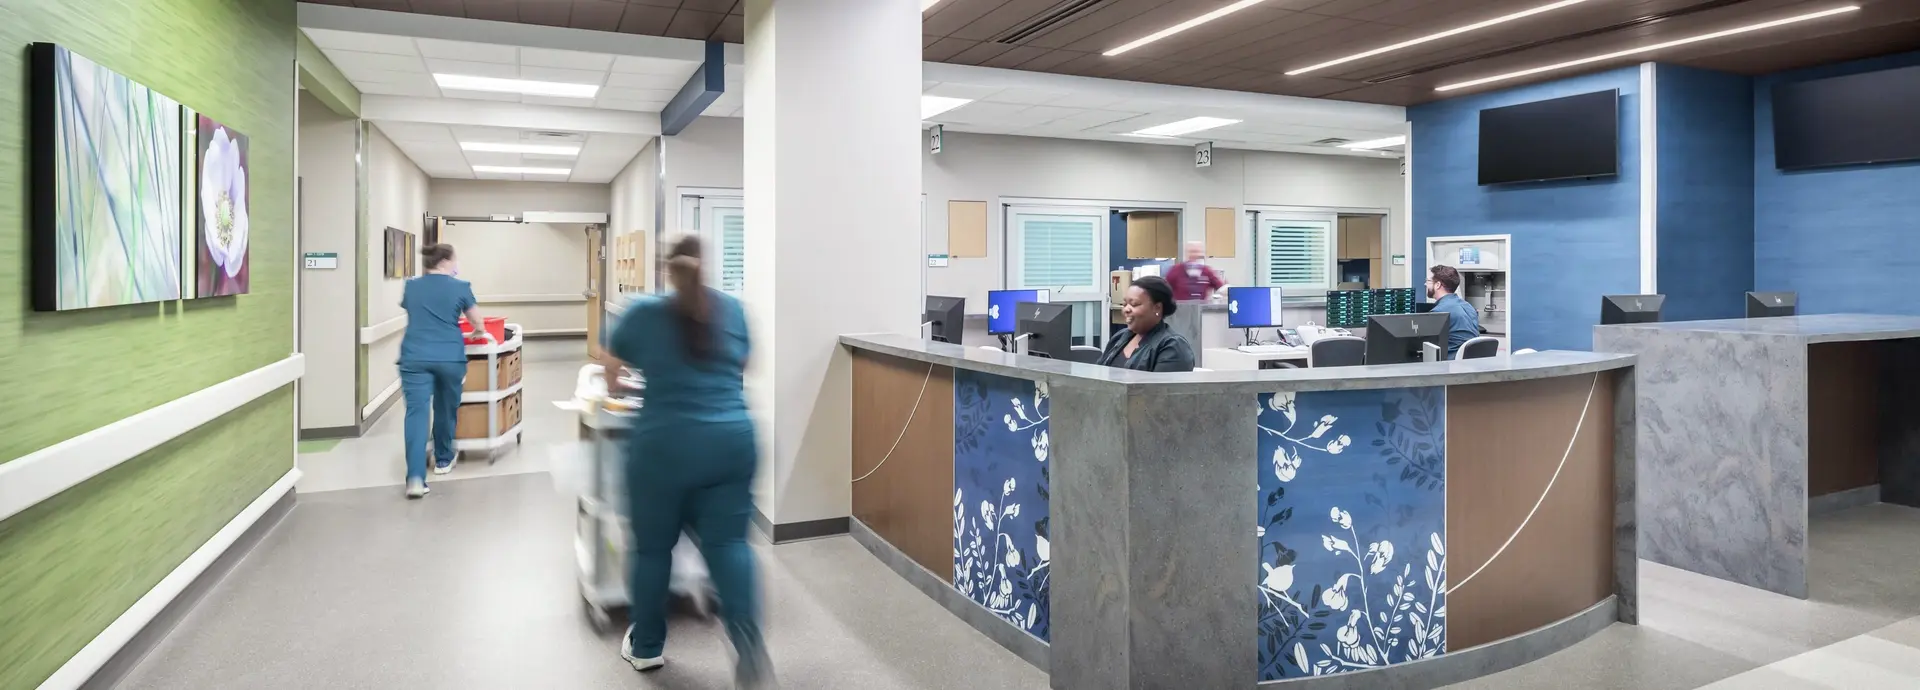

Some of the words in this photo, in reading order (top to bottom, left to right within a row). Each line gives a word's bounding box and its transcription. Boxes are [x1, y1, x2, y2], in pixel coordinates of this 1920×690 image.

[931, 135, 940, 151] 22
[1196, 150, 1209, 165] 23
[1400, 162, 1405, 175] 2
[307, 259, 317, 267] 21
